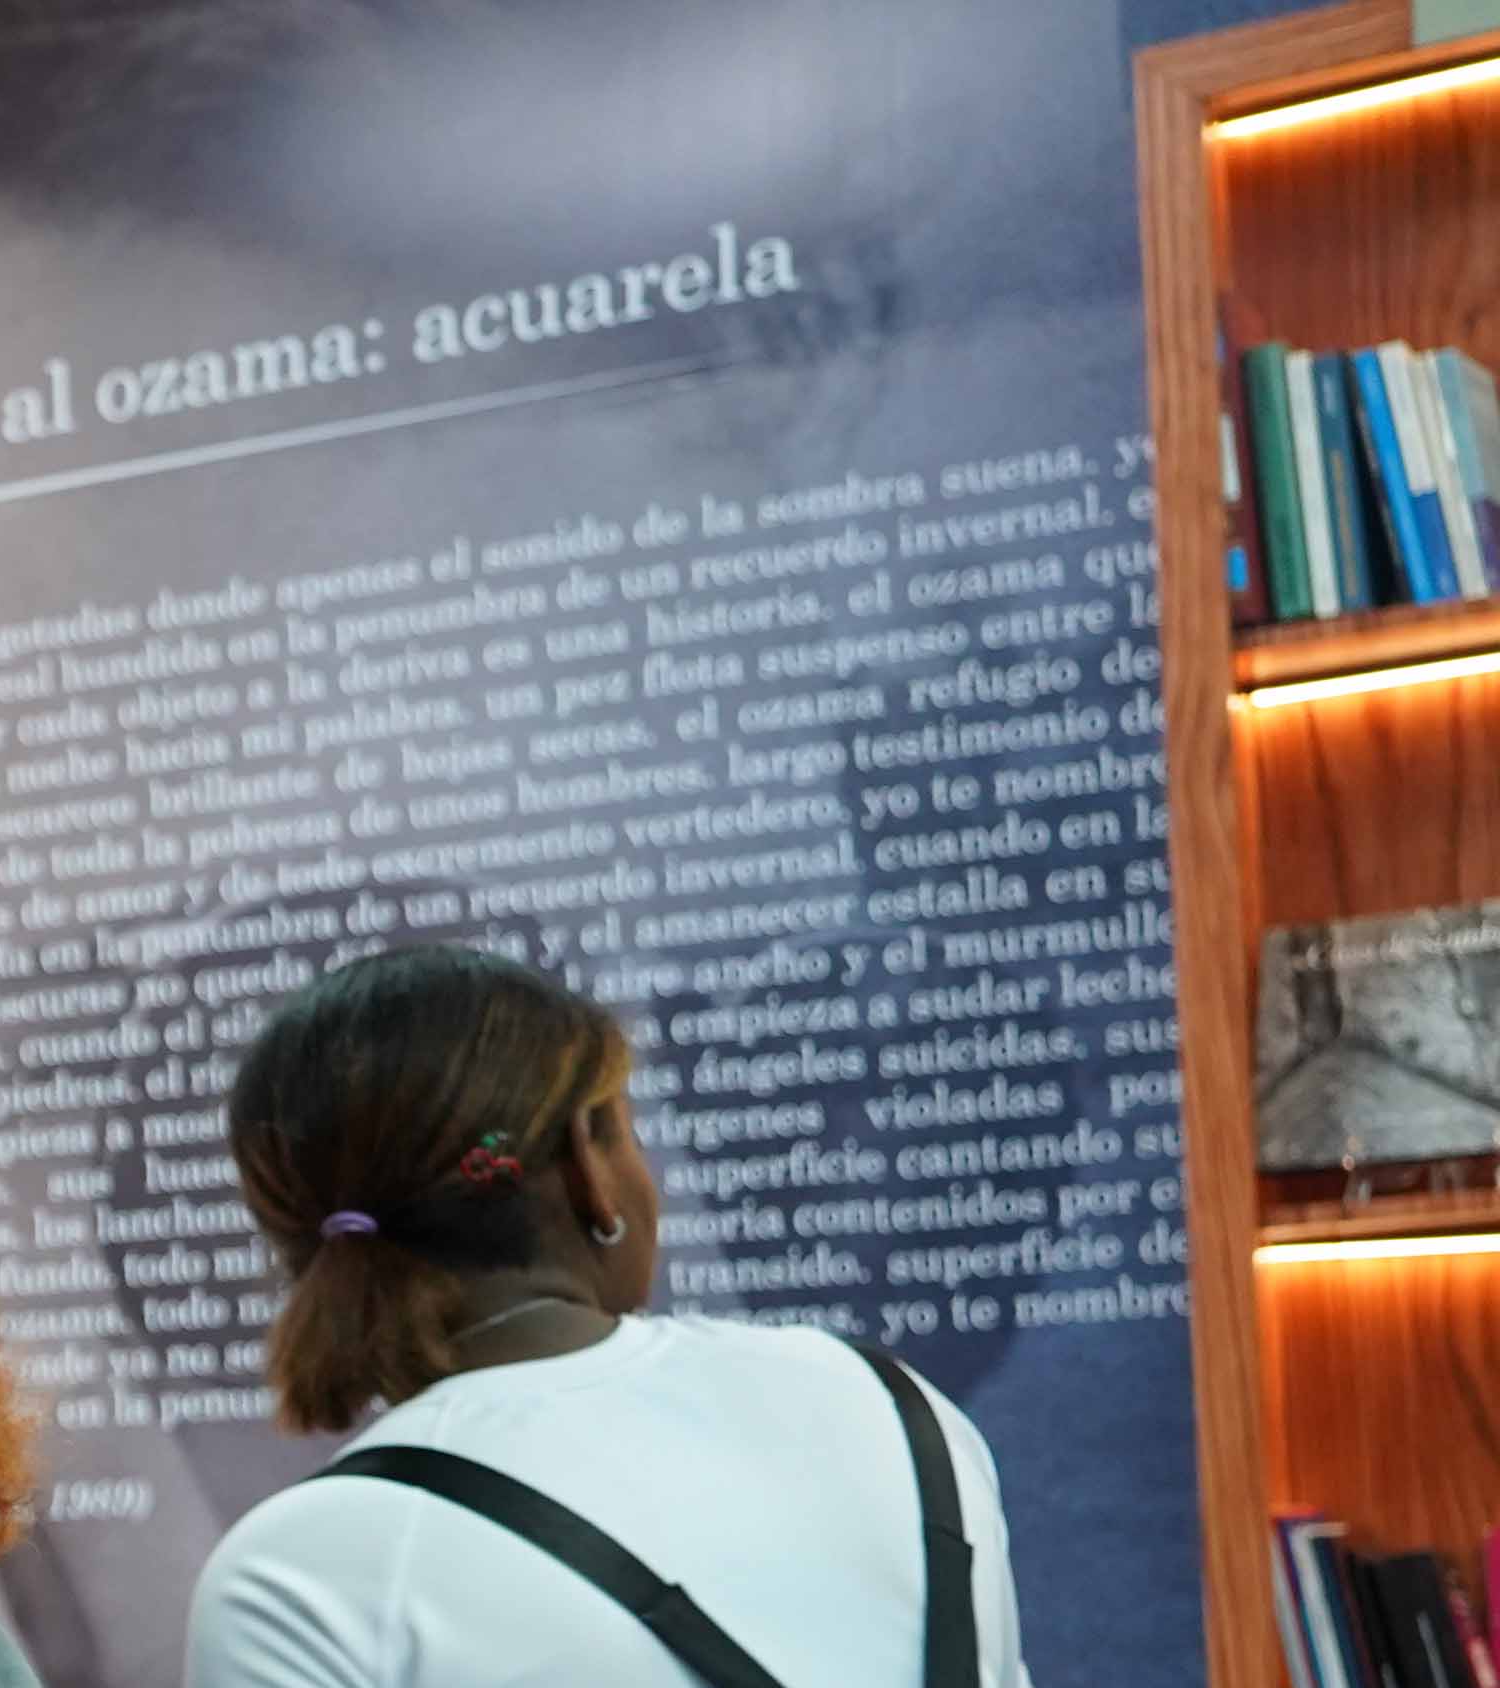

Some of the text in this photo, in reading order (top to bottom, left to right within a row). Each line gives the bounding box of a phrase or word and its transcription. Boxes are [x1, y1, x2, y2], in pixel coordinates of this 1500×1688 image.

[1, 357, 78, 449] al
[95, 315, 389, 425] ozama:
[411, 222, 802, 365] acuarela
[632, 502, 687, 547] de
[700, 493, 743, 537] la
[757, 470, 924, 527] sombra
[286, 617, 325, 654] la
[619, 564, 678, 599] un
[690, 525, 886, 589] recuerdo
[847, 570, 891, 615] el
[907, 555, 1063, 606] ozama
[642, 602, 1112, 697] flota suspenso entre
[675, 659, 1080, 741] el ozama refugio
[727, 698, 1108, 785] largo testimonio
[861, 786, 919, 829] yo
[931, 776, 979, 811] te
[404, 894, 460, 927] un
[469, 859, 655, 920] recuerdo
[874, 810, 1050, 870] cuando
[1059, 811, 1120, 848] en
[193, 865, 1105, 1006] queda el amanecer estalla en
[692, 941, 830, 993] ancho
[841, 945, 864, 985] y
[882, 926, 925, 973] el
[670, 971, 1048, 1046] empieza a sudar
[692, 1039, 865, 1095] ángeles
[630, 1102, 824, 1154] vírgenes
[864, 1074, 1062, 1129] violadas
[663, 1118, 1121, 1199] superficie cantando
[123, 1180, 1139, 1285] todo contenidos por
[143, 1289, 228, 1330] todo
[886, 1228, 1122, 1288] superficie
[166, 1345, 216, 1375] no
[881, 1303, 938, 1344] yo
[951, 1295, 998, 1331] te
